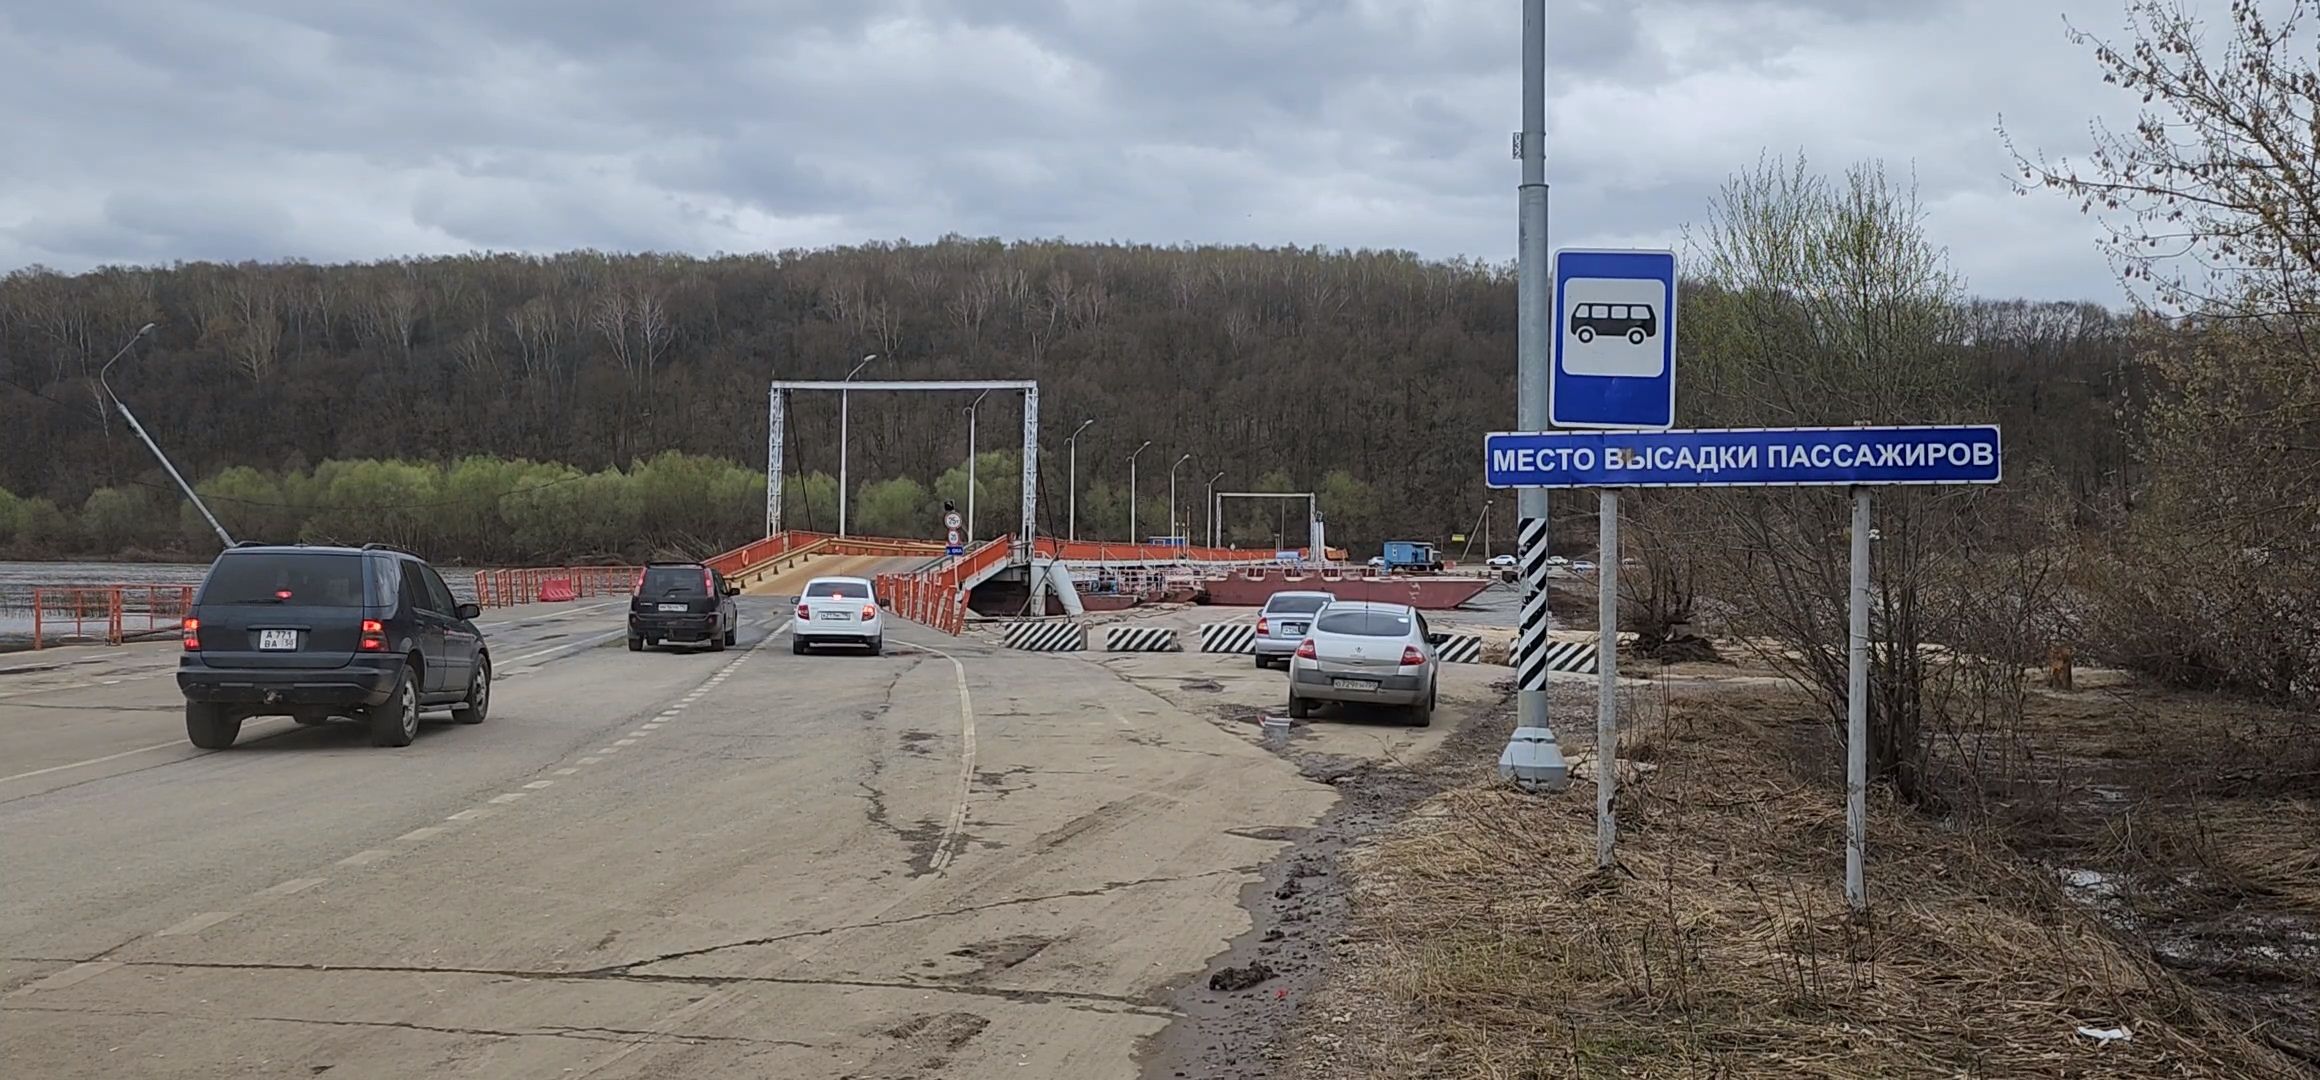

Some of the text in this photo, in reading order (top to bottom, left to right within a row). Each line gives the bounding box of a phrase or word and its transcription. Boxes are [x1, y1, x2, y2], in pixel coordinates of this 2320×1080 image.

[1493, 442, 1995, 473] МЕСТО ВЫСАДКИ ПАССАЖИРОВ
[266, 630, 292, 639] А 771
[264, 639, 278, 648] ВА
